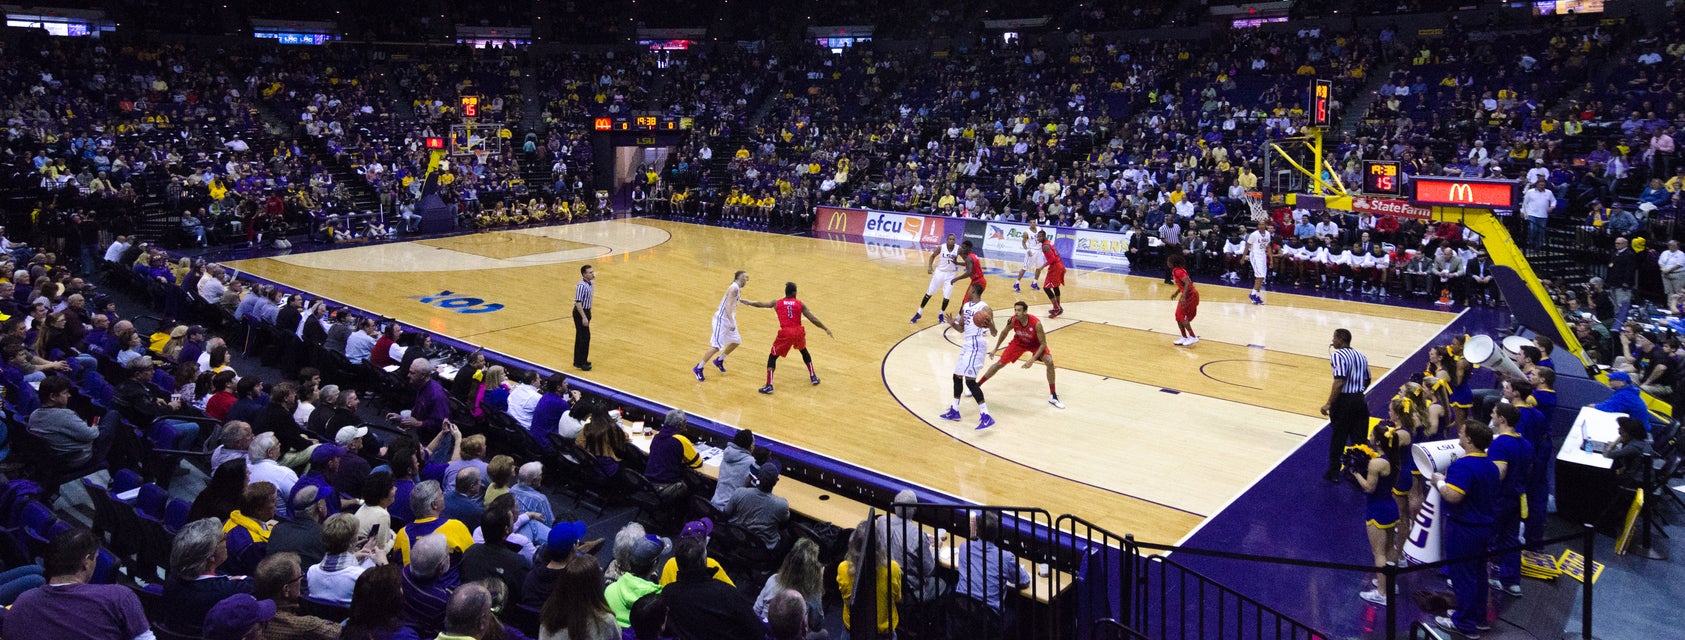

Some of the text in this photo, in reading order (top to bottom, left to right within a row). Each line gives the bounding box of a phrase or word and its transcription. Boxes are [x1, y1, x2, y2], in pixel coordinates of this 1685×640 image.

[622, 122, 628, 130] 0
[636, 116, 657, 126] 19:38
[668, 121, 674, 129] 0
[1371, 164, 1397, 178] 19:38
[1377, 176, 1392, 190] 15
[867, 214, 903, 234] efcu
[1437, 443, 1456, 451] LSU
